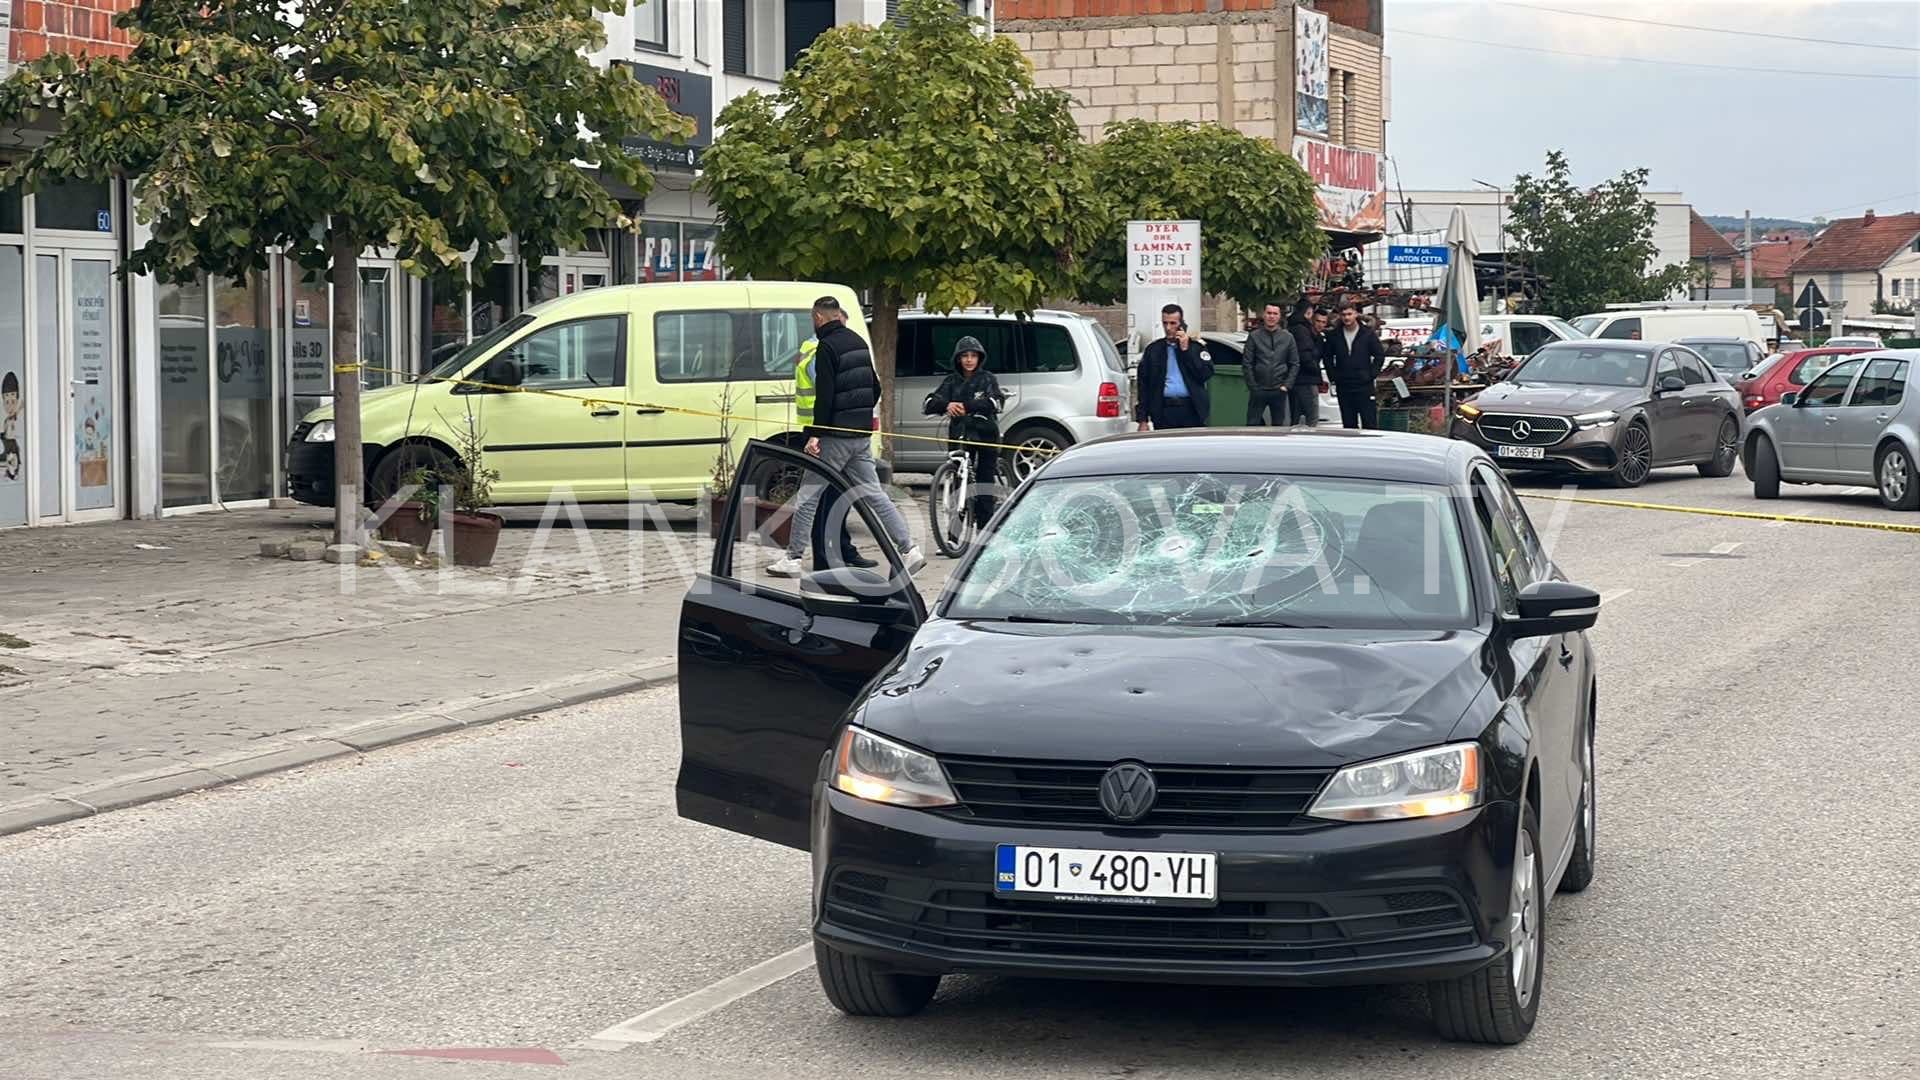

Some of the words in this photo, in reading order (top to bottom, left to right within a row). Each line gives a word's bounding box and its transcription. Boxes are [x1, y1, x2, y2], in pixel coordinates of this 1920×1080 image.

[97, 211, 111, 230] 60
[1146, 224, 1179, 232] DYER
[1134, 243, 1192, 251] LAMINAT
[1140, 254, 1186, 267] BESI
[1393, 255, 1420, 263] ANTON
[309, 342, 322, 358] 3D
[1500, 446, 1510, 456] 01
[1024, 851, 1059, 889] 01
